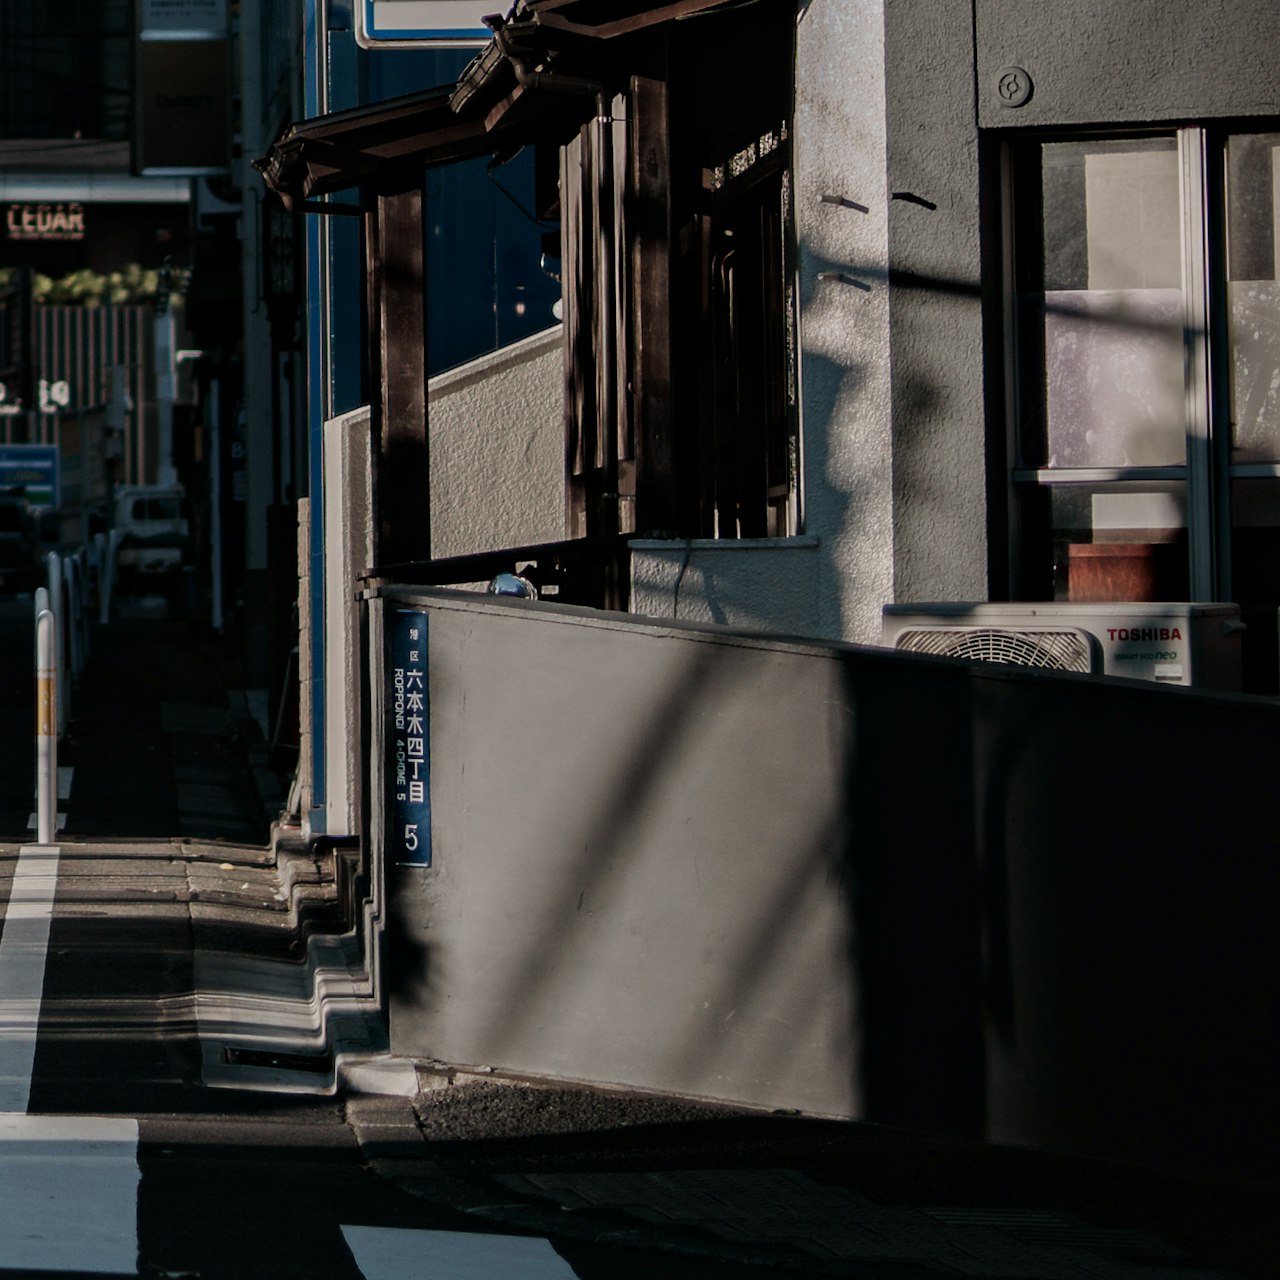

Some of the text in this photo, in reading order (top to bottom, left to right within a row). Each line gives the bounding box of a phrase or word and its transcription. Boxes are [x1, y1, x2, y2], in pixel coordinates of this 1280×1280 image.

[1107, 628, 1182, 641] TOSHIBA
[393, 668, 407, 801] ROPPONGI 4-CHOME 5
[406, 668, 425, 803] 六本木四丁目
[405, 824, 419, 851] 5
